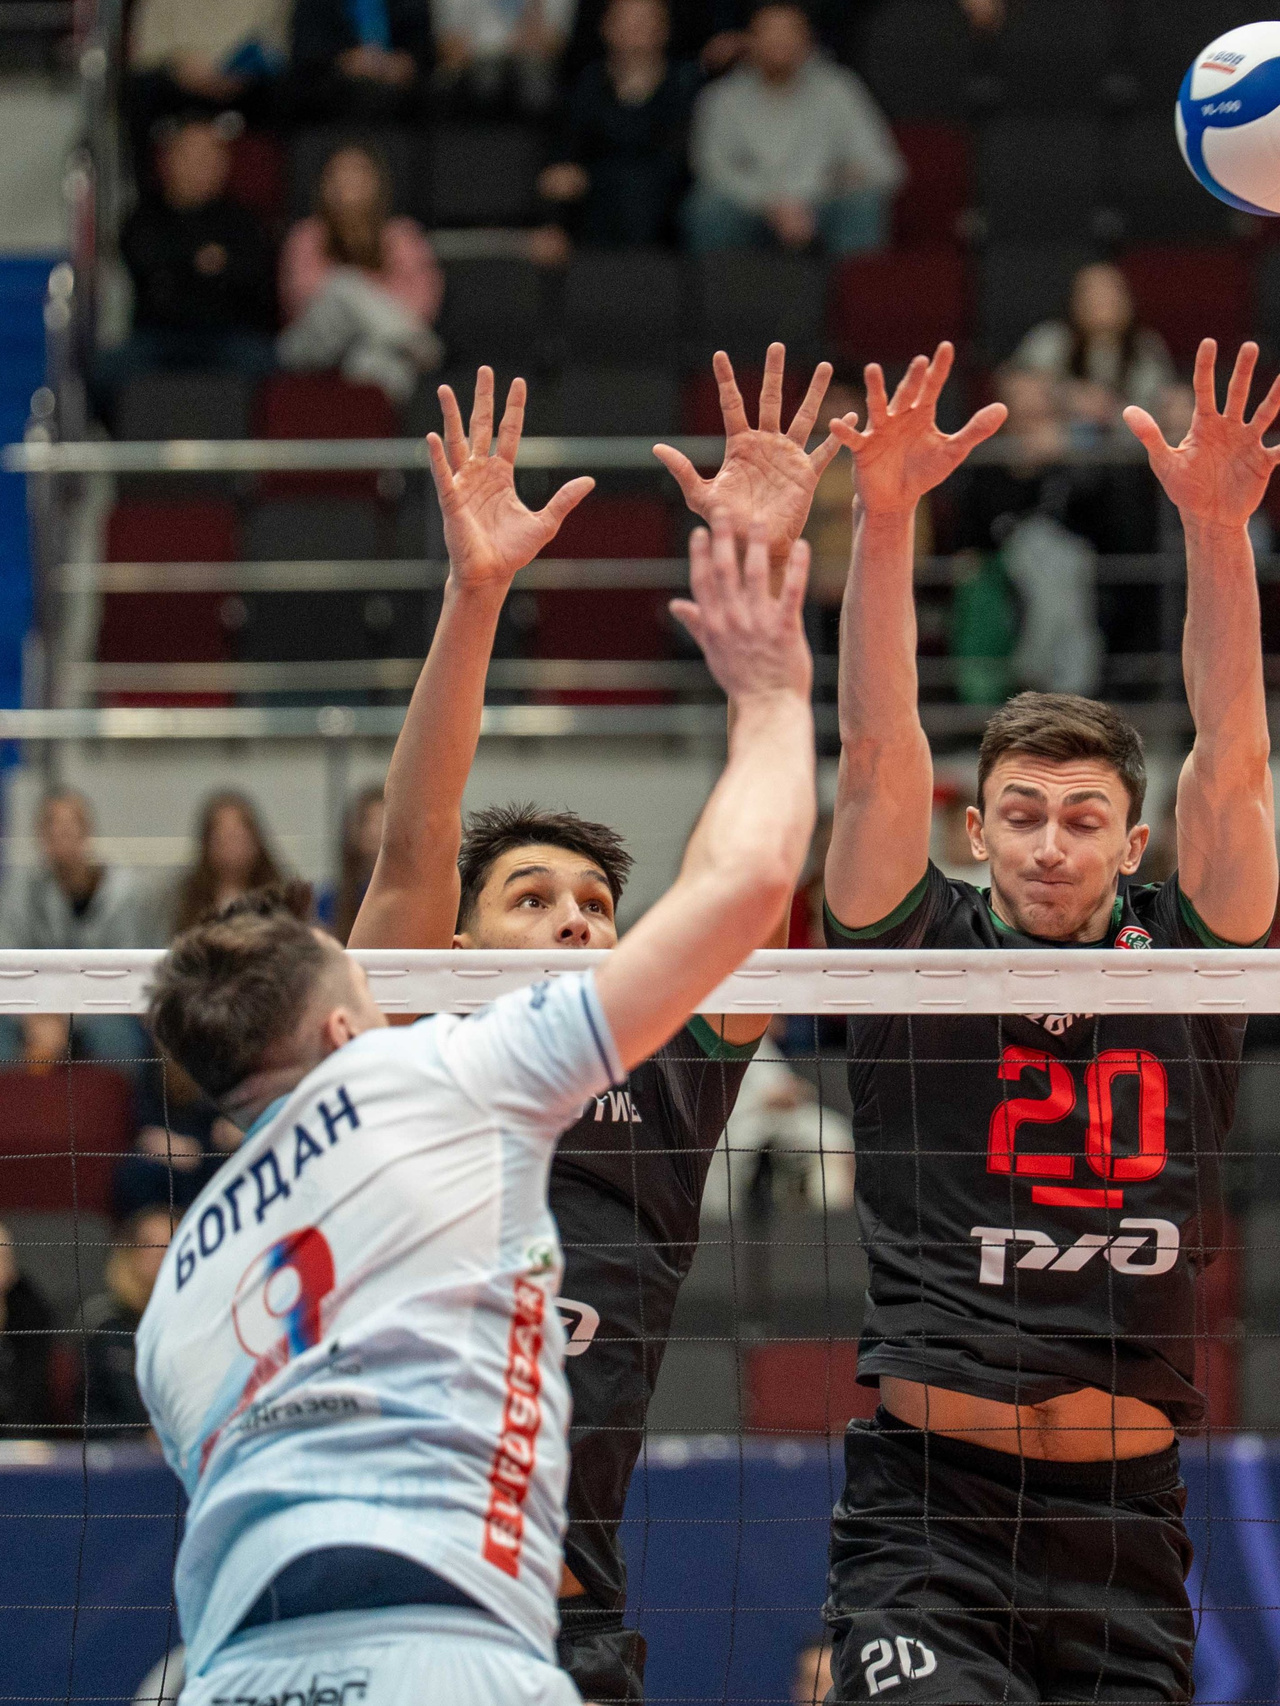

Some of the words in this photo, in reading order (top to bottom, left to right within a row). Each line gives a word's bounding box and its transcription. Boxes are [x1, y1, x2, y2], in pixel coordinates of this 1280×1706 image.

[986, 1044, 1169, 1182] 20
[175, 1085, 361, 1293] БОГДАН
[861, 1635, 938, 1697] 20
